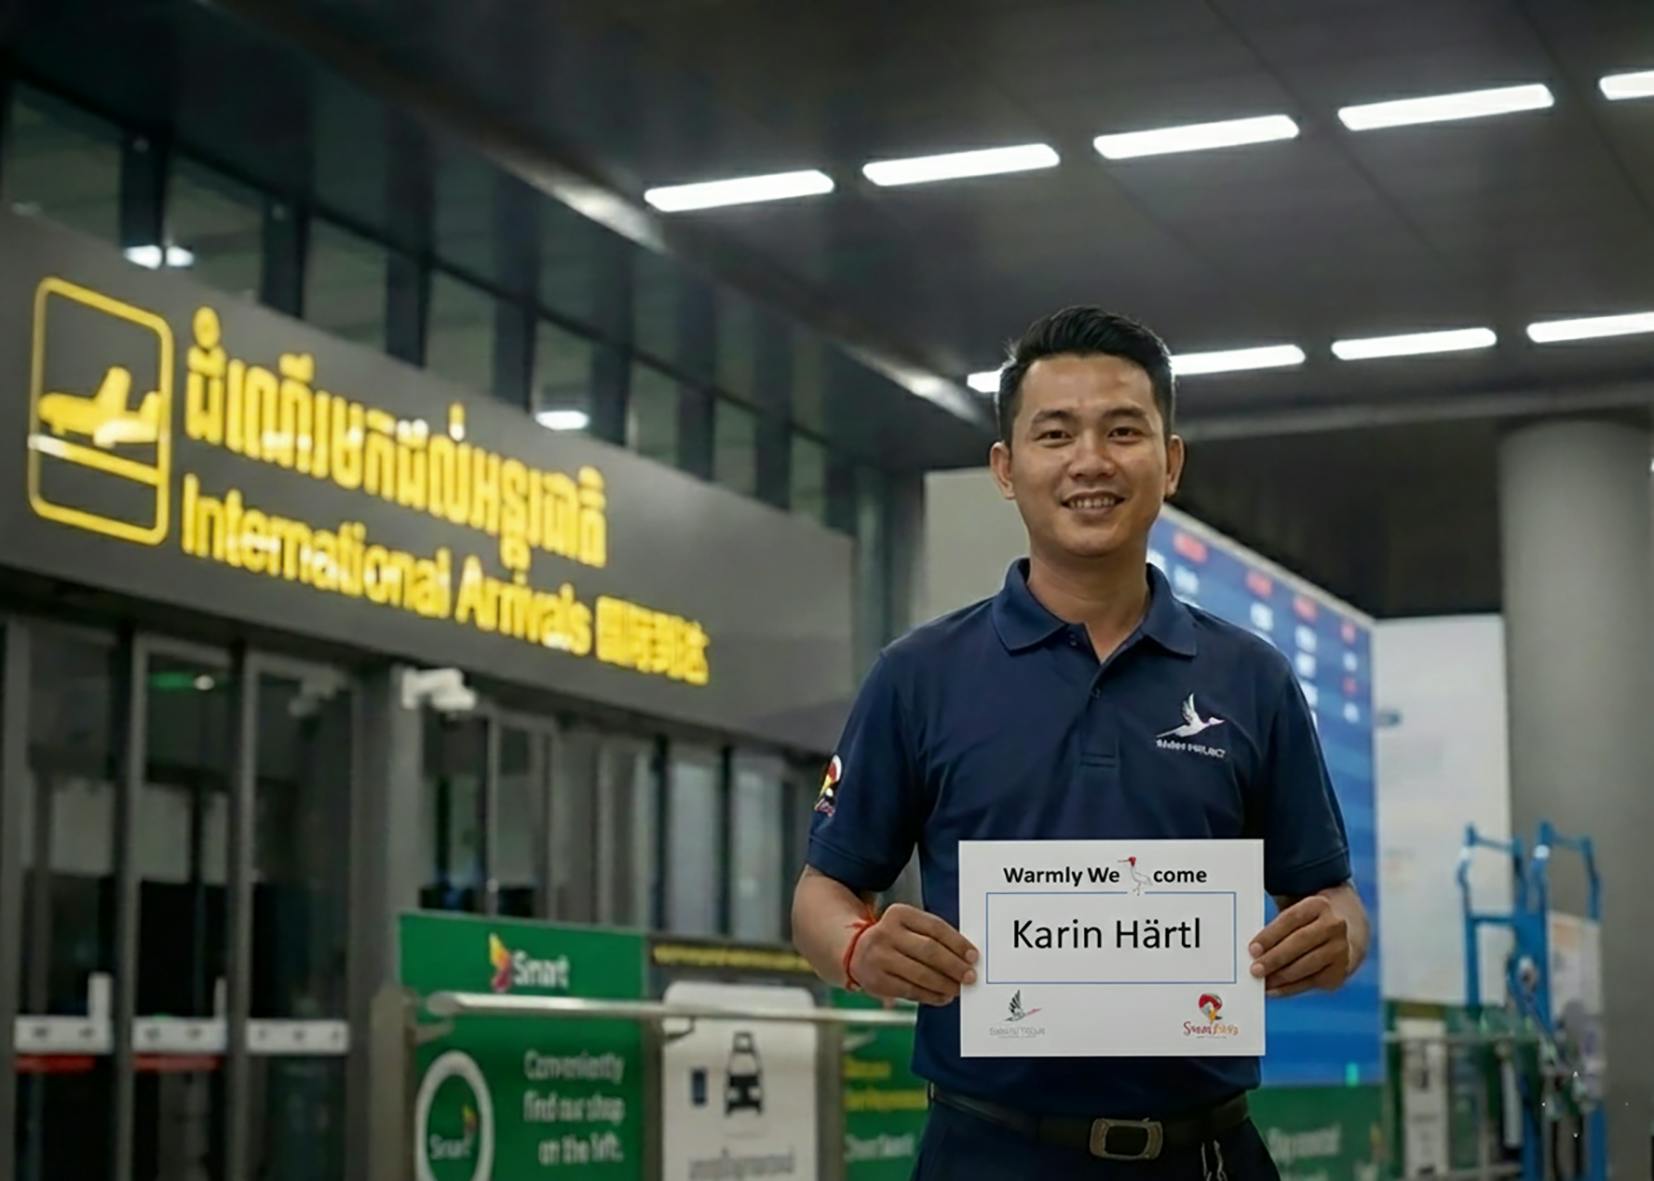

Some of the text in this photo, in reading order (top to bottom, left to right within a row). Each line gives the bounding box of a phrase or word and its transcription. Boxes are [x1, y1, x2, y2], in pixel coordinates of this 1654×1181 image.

[182, 473, 592, 656] International Arrivals
[1003, 866, 1083, 887] Warmly
[1013, 917, 1201, 949] Karin Härtl
[512, 951, 570, 988] Smart
